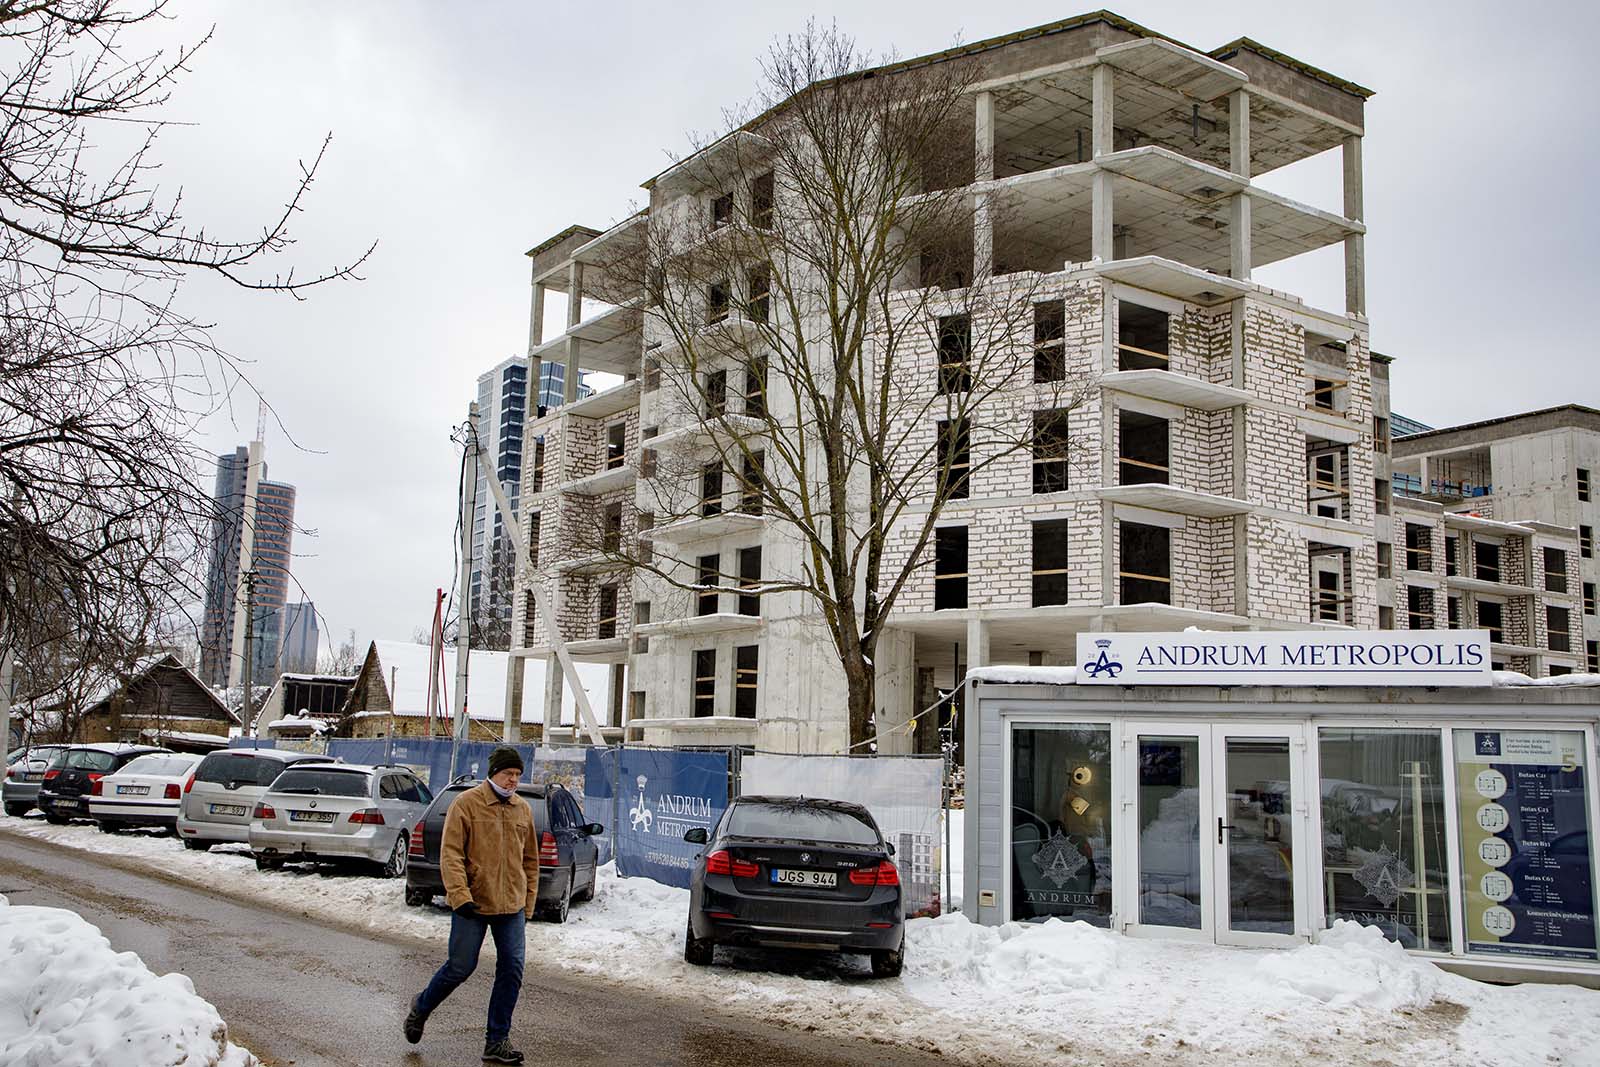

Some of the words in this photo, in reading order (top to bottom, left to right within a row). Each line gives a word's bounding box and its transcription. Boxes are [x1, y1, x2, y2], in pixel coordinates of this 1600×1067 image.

[1136, 644, 1267, 666] ANDRUM
[1280, 643, 1483, 667] METROPOLIS
[1561, 754, 1577, 773] 5
[656, 794, 712, 817] ANDRUM
[656, 821, 711, 840] METROS
[779, 870, 804, 883] JGS
[813, 872, 835, 885] 944
[1027, 891, 1095, 905] ANDRUM
[1348, 911, 1424, 926] ANDRU
